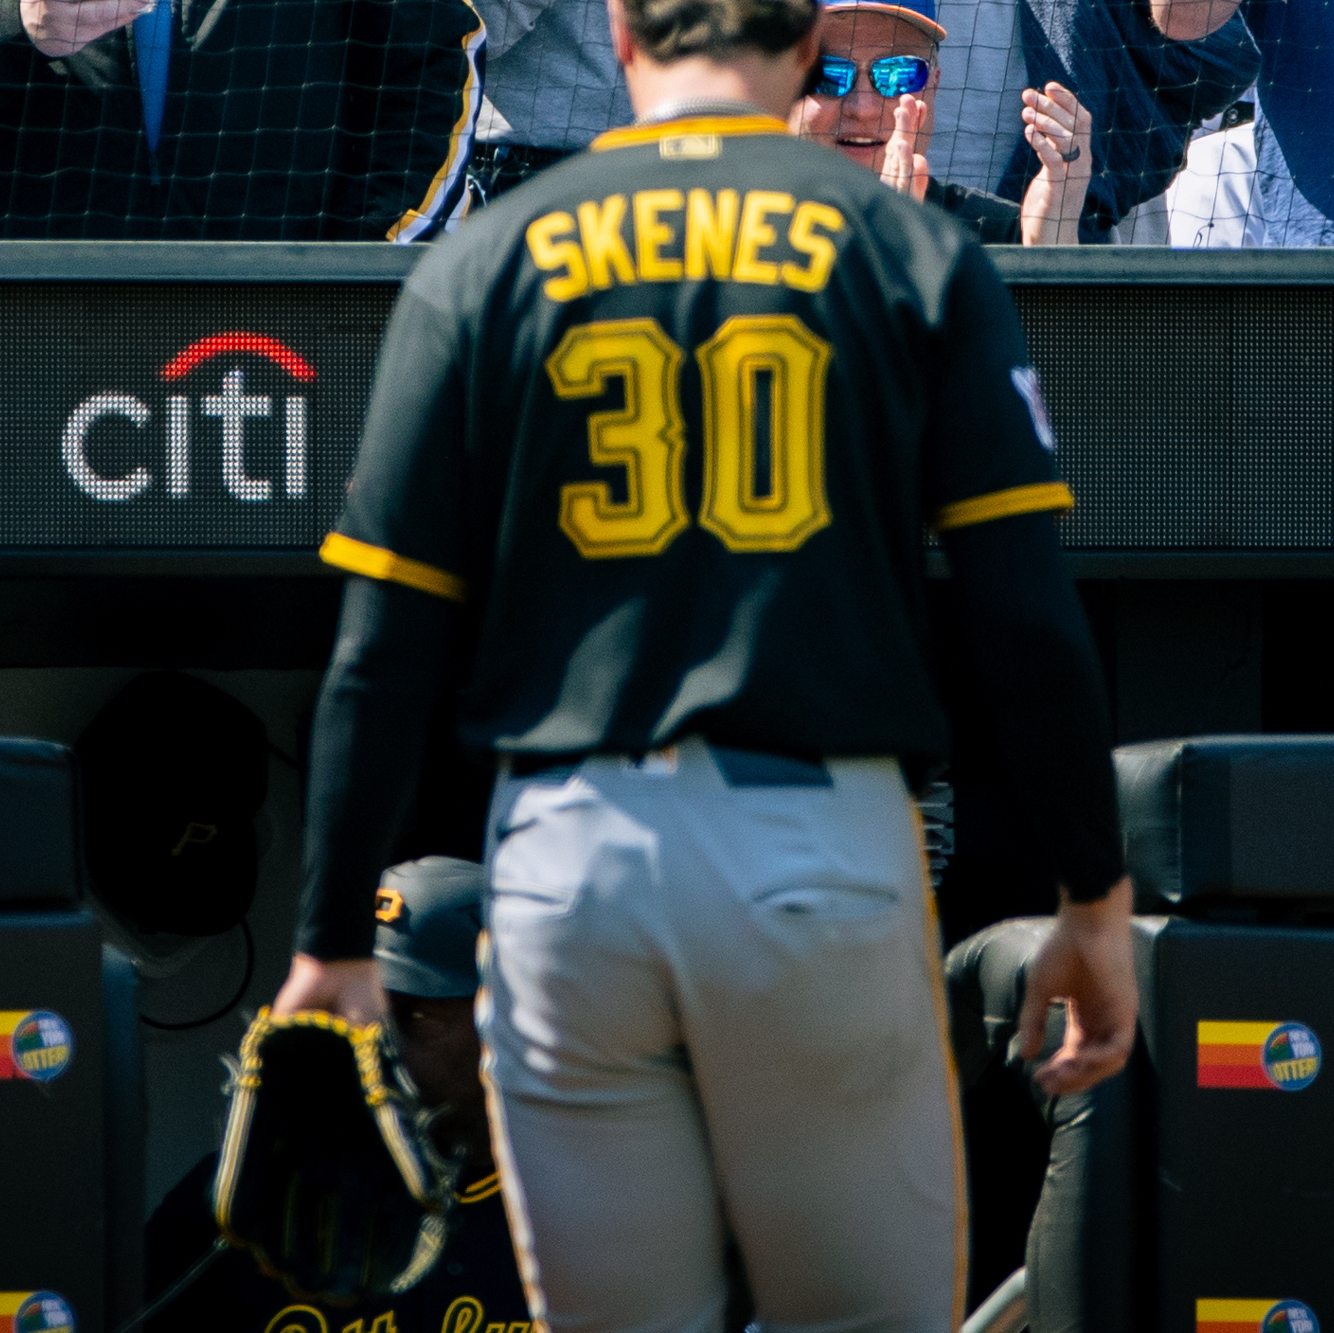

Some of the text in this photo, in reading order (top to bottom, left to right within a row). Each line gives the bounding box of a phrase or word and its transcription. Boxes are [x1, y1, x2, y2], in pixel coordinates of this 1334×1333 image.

[525, 187, 847, 303] SKENES
[61, 368, 308, 502] citi
[544, 313, 834, 560] 30
